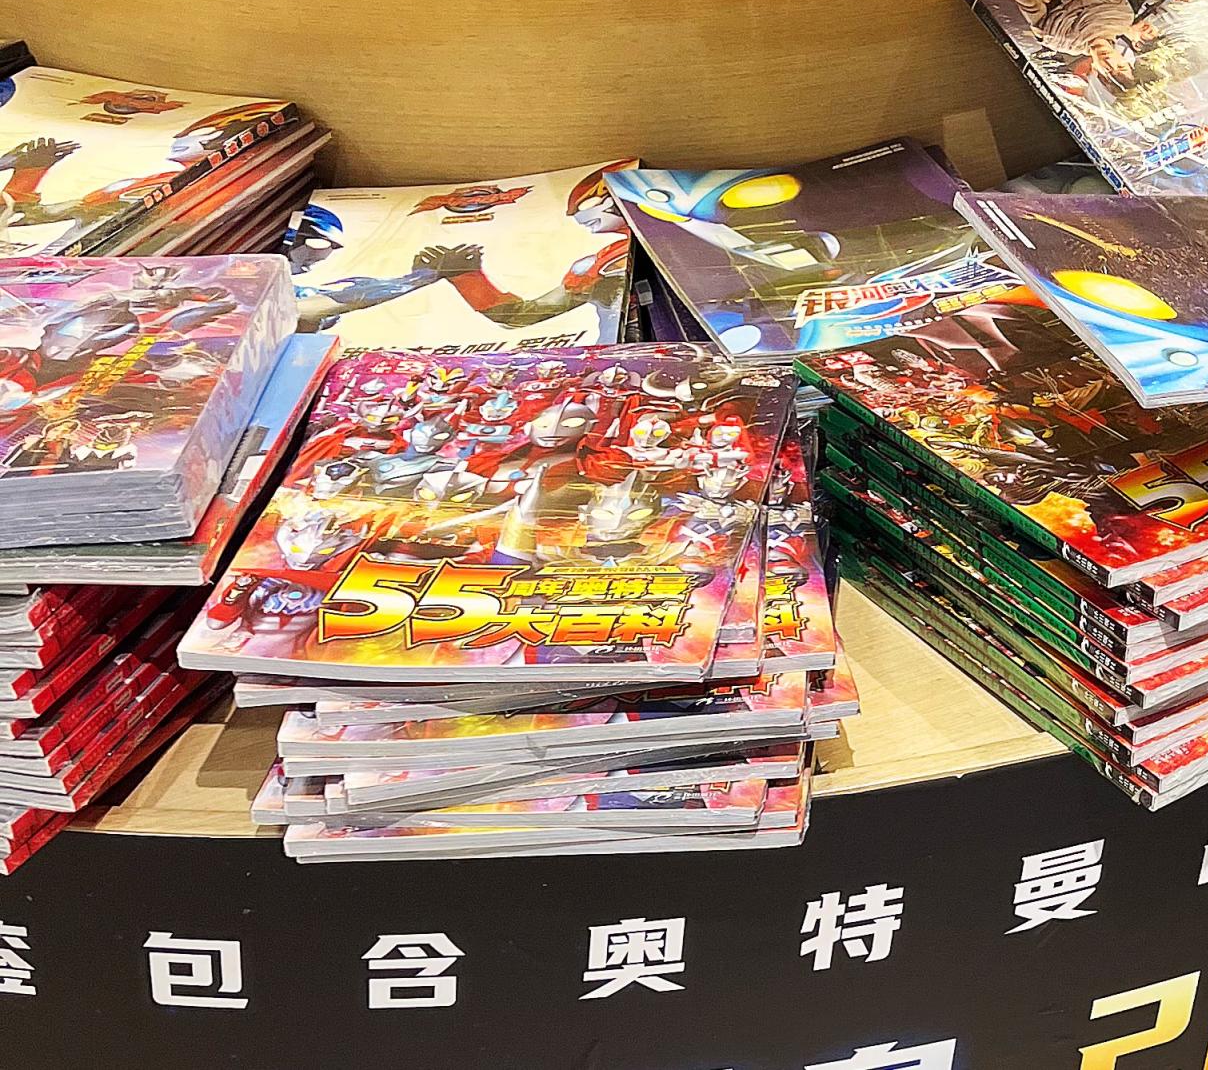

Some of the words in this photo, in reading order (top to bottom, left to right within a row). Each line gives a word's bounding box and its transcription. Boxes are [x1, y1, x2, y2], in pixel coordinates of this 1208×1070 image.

[319, 555, 529, 648] 55
[506, 574, 692, 605] 周年奥特曼
[480, 601, 690, 648] 大百科
